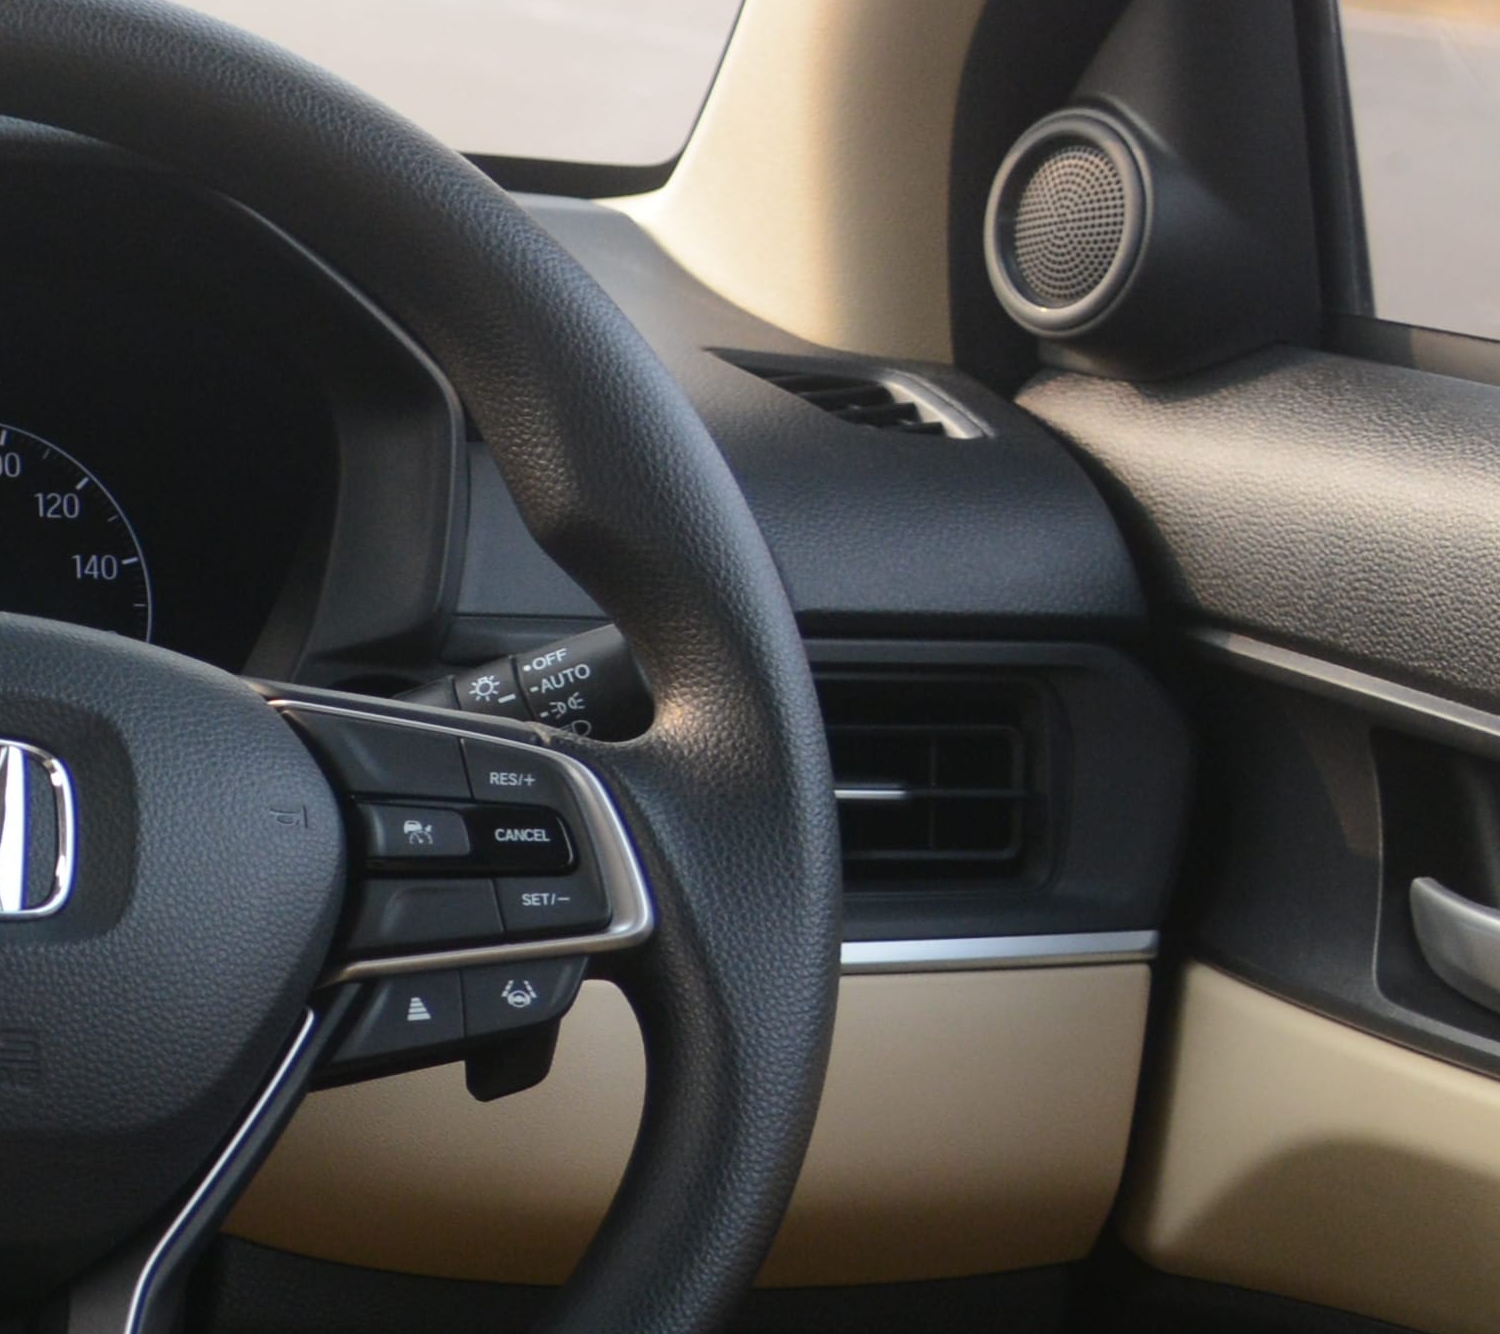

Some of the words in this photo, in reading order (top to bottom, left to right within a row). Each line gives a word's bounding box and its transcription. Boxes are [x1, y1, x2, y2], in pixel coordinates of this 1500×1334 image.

[34, 493, 80, 518] 120
[72, 555, 118, 580] 140
[532, 648, 567, 670] OFF
[541, 664, 590, 694] AUTO
[494, 828, 551, 842] CANCEL
